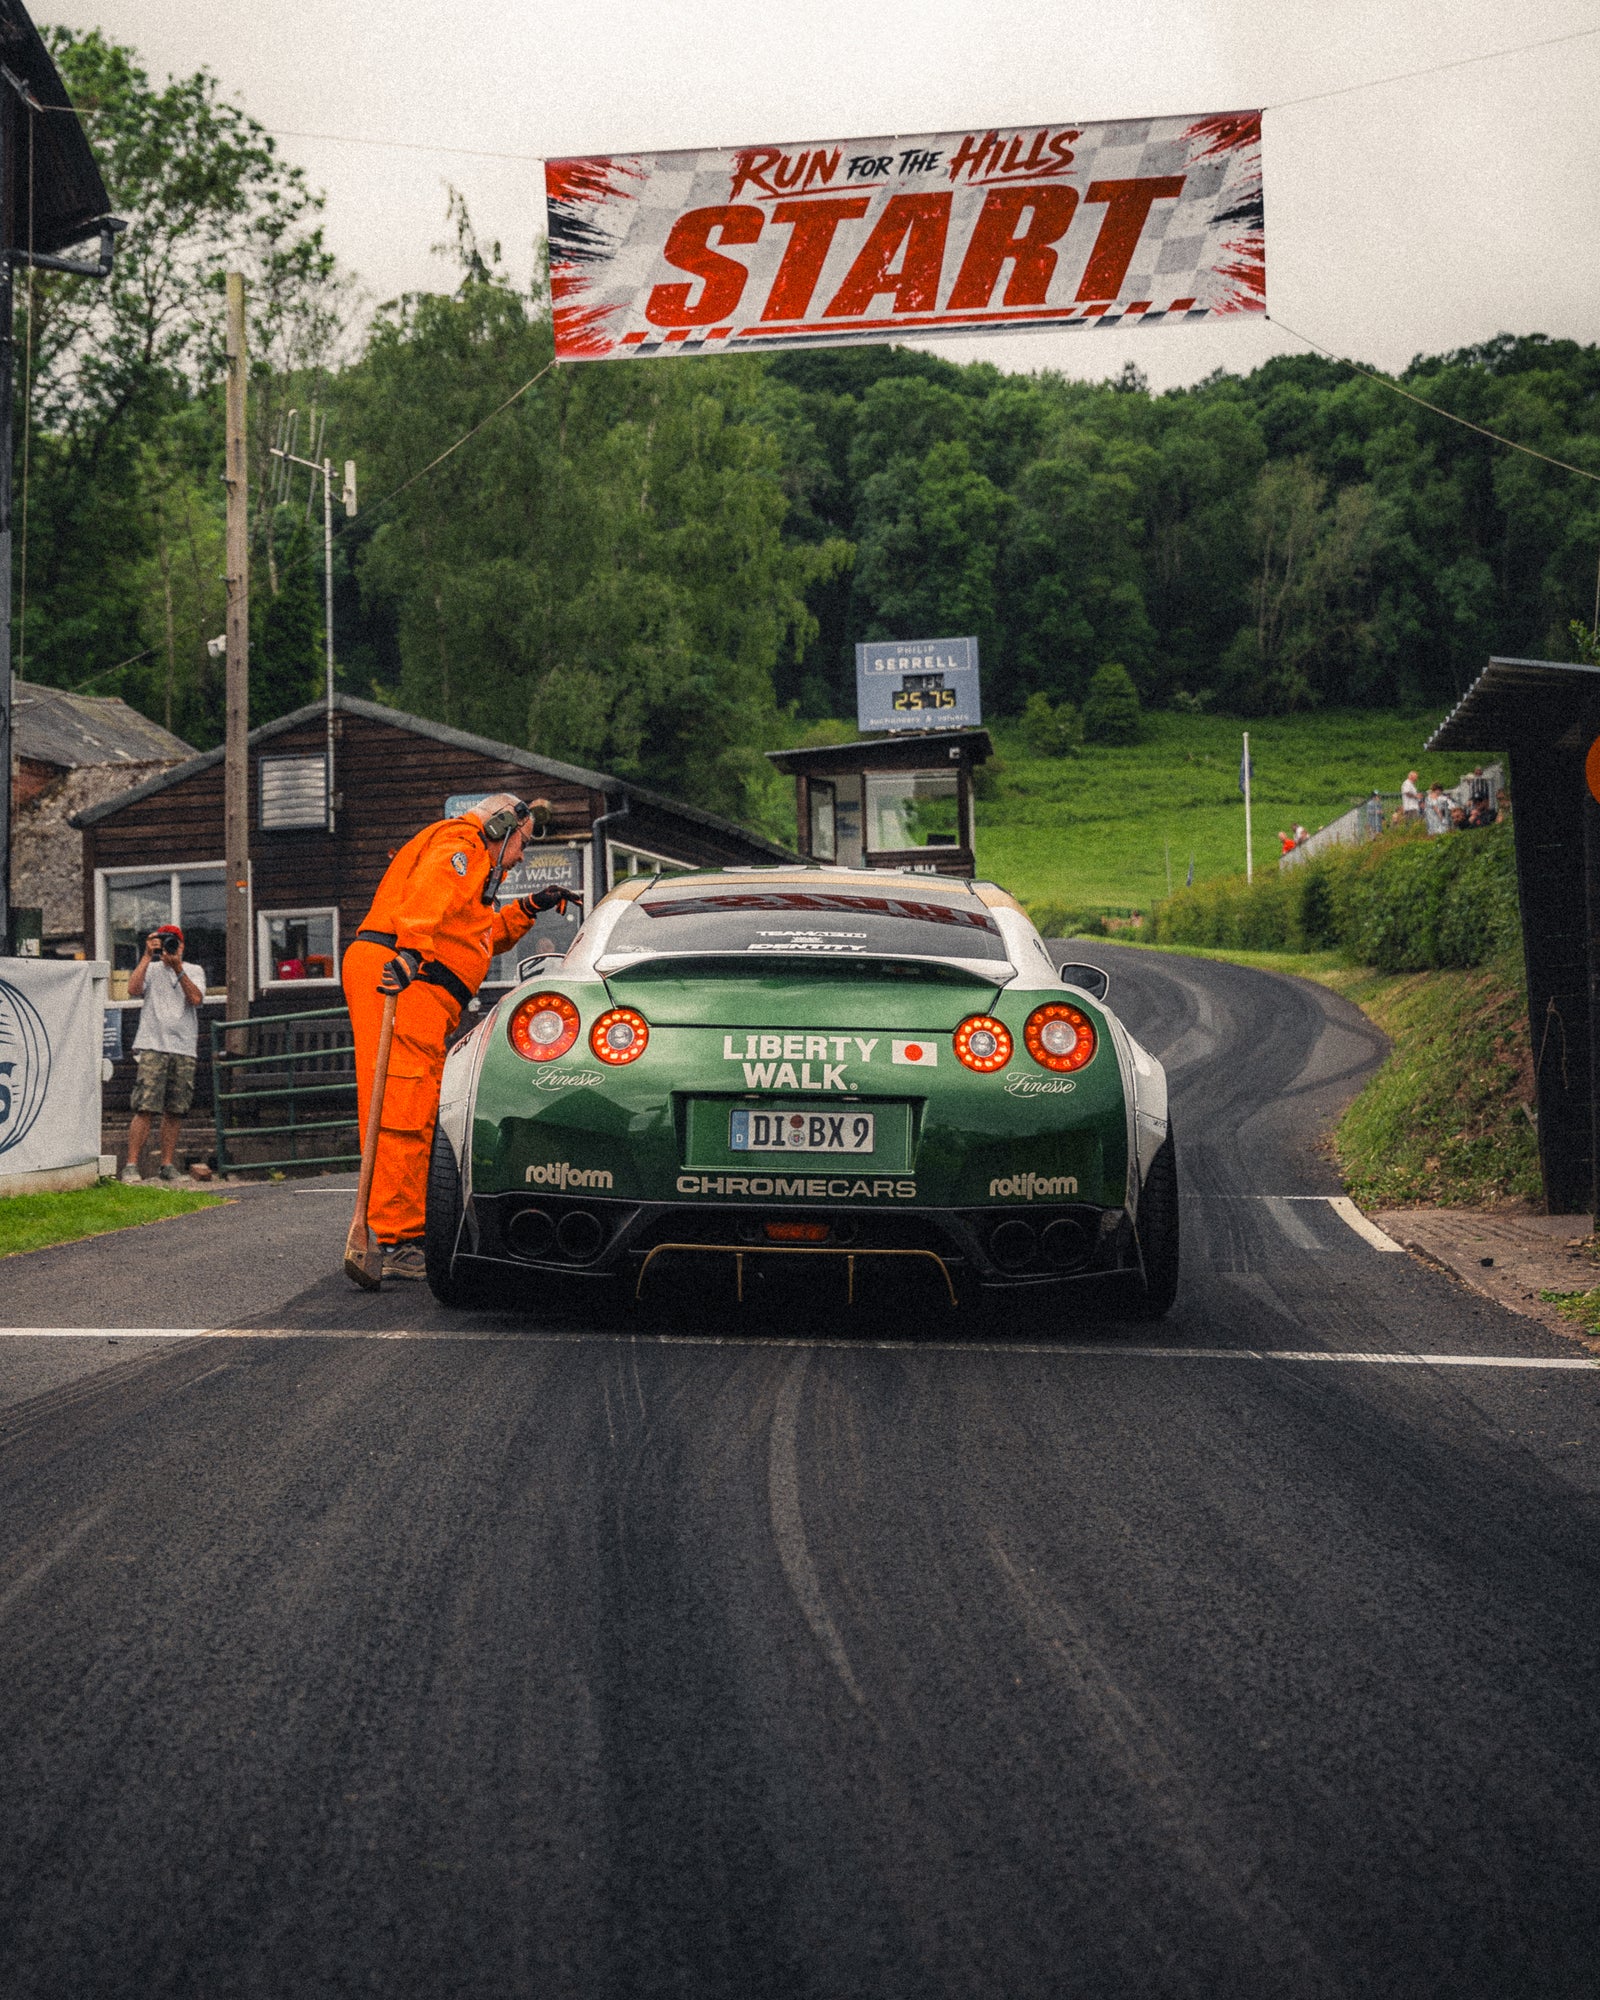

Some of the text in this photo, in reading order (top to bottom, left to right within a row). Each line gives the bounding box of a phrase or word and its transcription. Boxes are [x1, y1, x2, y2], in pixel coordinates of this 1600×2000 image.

[729, 128, 1083, 203] RUN FOR THE HILLS
[645, 175, 1186, 328] START
[897, 645, 935, 655] PHILIP
[874, 655, 958, 672] SERRELL
[525, 866, 572, 881] WALSH
[747, 943, 867, 951] IDENTITY
[723, 1035, 879, 1062] LIBERTY
[532, 1065, 606, 1091] Finesse
[1004, 1072, 1077, 1098] Finesse
[753, 1115, 786, 1147] DI
[525, 1162, 613, 1190] rotiform
[676, 1175, 917, 1199] CHROMECARS
[989, 1172, 1078, 1200] rotiform
